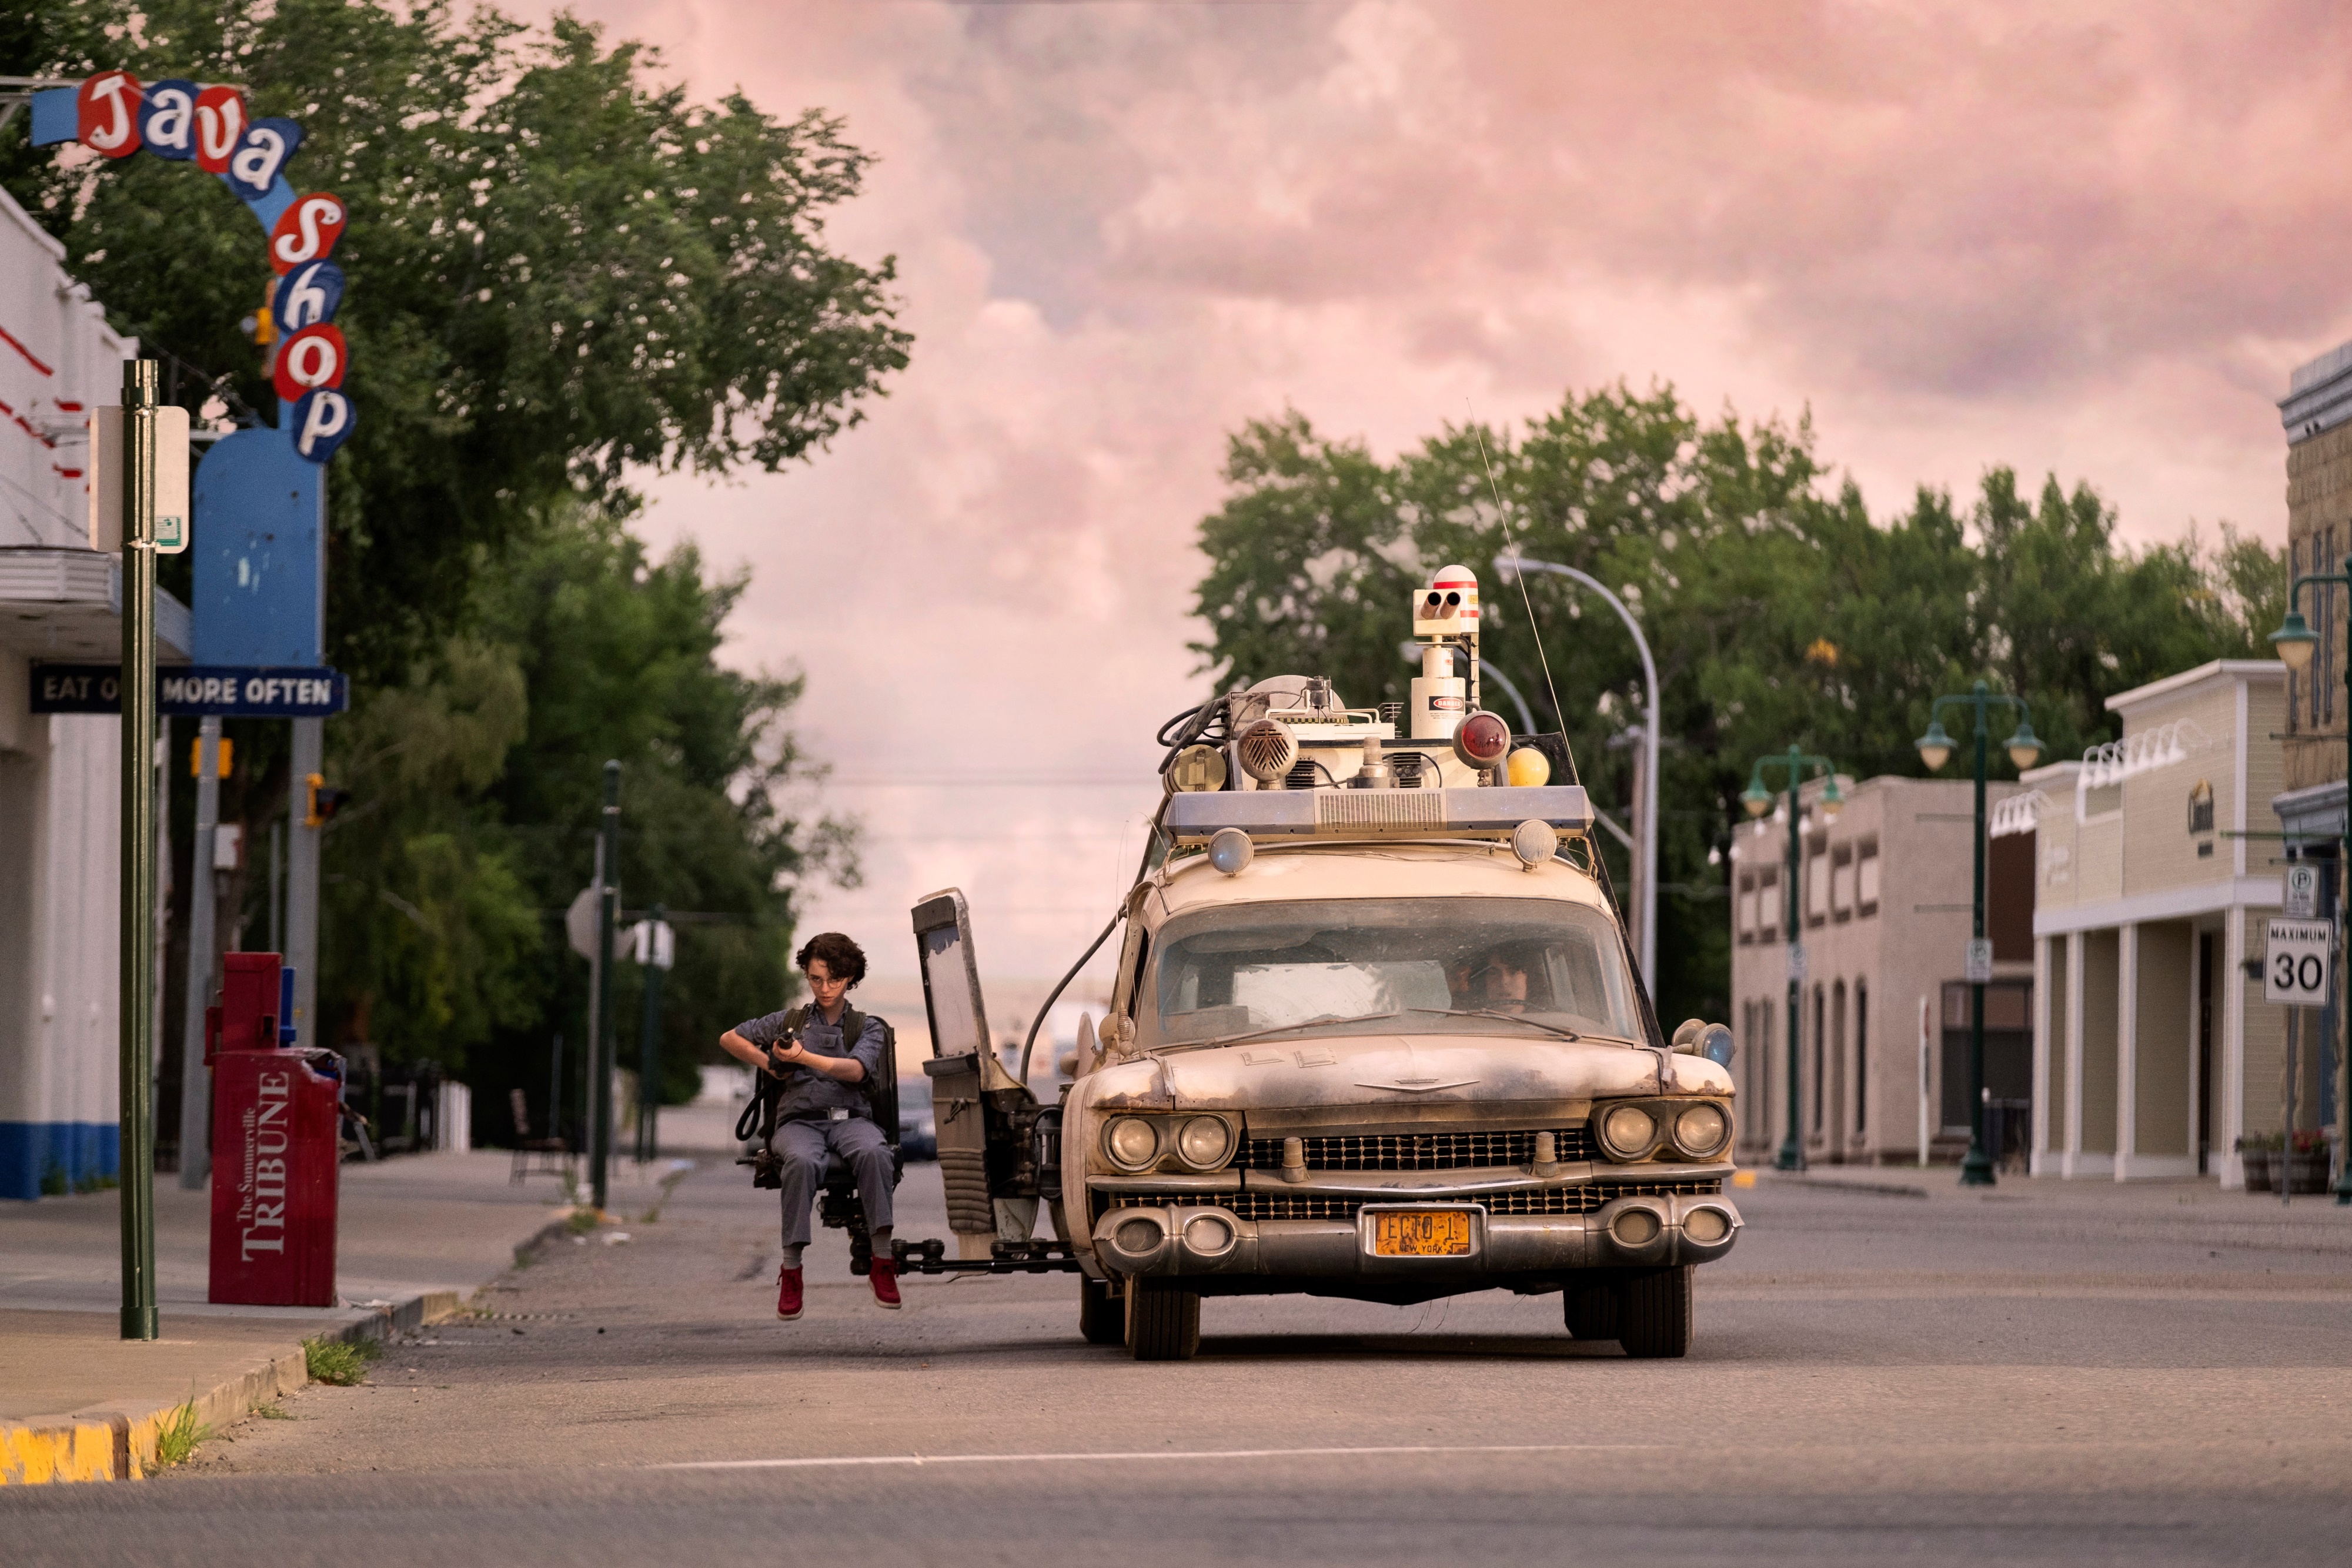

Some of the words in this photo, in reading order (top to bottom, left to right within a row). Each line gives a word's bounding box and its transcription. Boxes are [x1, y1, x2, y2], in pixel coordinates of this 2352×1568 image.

[90, 75, 286, 190] Java
[274, 198, 348, 456] Shop
[44, 676, 92, 701] EAT
[162, 676, 238, 705] MORE
[244, 677, 332, 706] OFTEN
[2271, 927, 2326, 942] MAXIMUM
[2274, 952, 2323, 992] 30
[238, 1106, 256, 1192] Summerville
[241, 1071, 289, 1262] TRIBUNE
[236, 1195, 253, 1222] The
[1399, 1243, 1418, 1252] NEW
[1421, 1245, 1443, 1253] YORK
